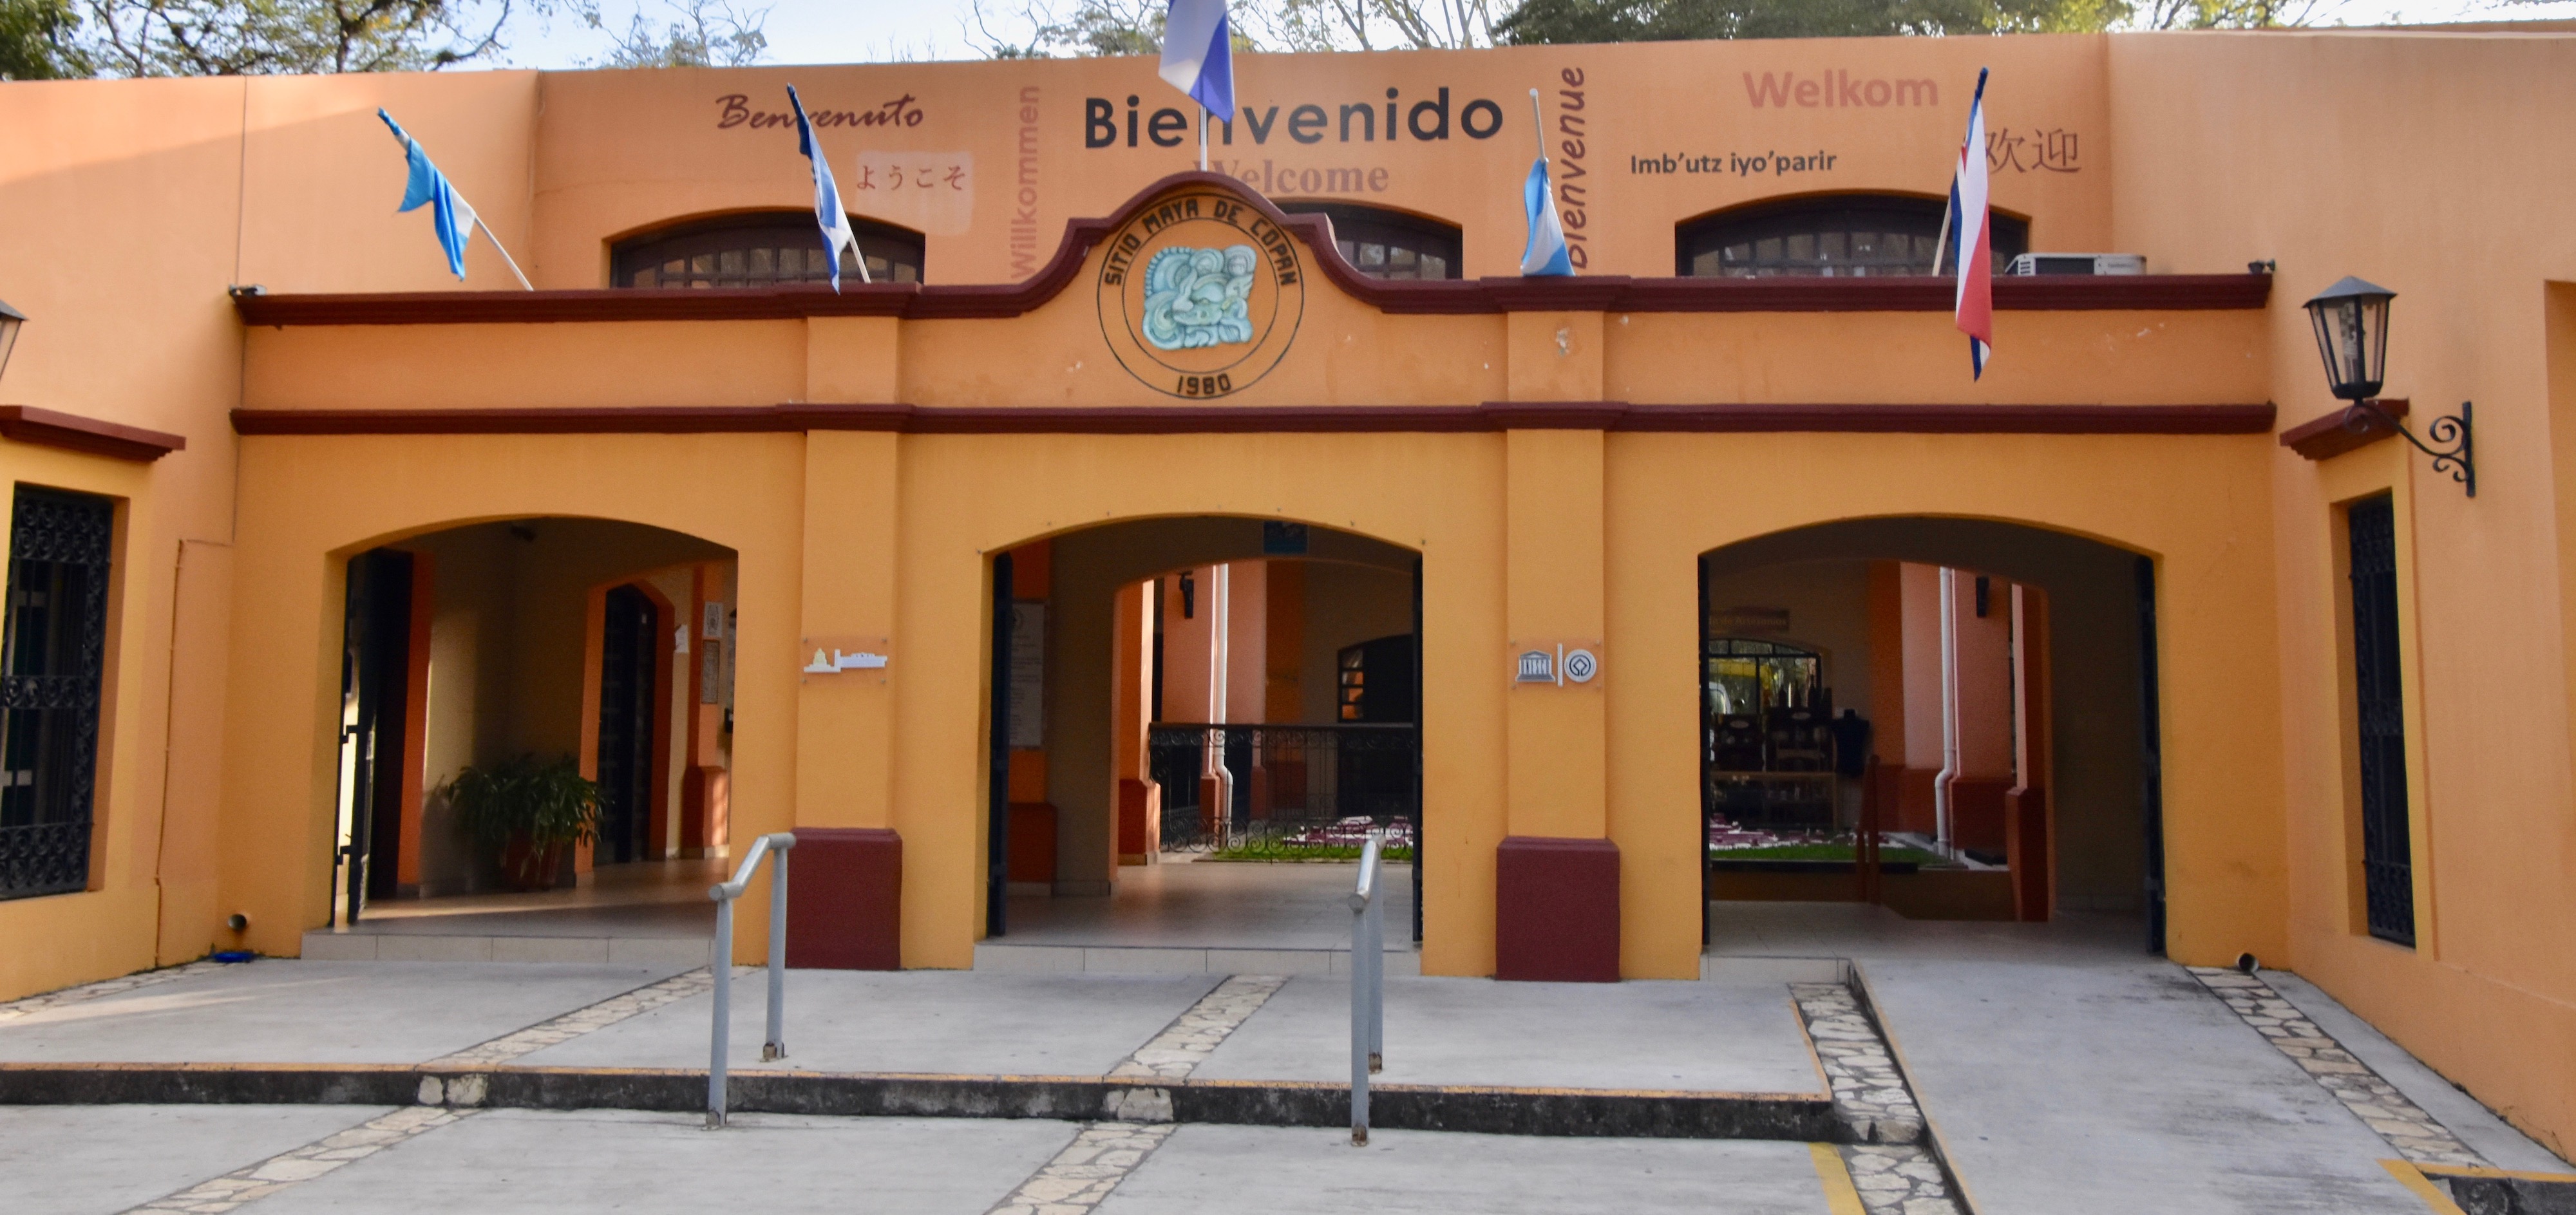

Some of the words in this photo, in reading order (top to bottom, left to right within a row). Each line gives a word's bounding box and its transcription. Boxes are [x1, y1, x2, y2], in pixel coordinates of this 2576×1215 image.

[1743, 68, 1938, 109] Welkom
[857, 164, 965, 191] ようこそ
[1010, 86, 1040, 279] Willkommen
[1104, 232, 1141, 286] SITIO
[1142, 199, 1199, 234] MAYA
[1214, 200, 1244, 225] DE
[1250, 217, 1297, 286] COPAN
[1177, 373, 1233, 395] 1980
